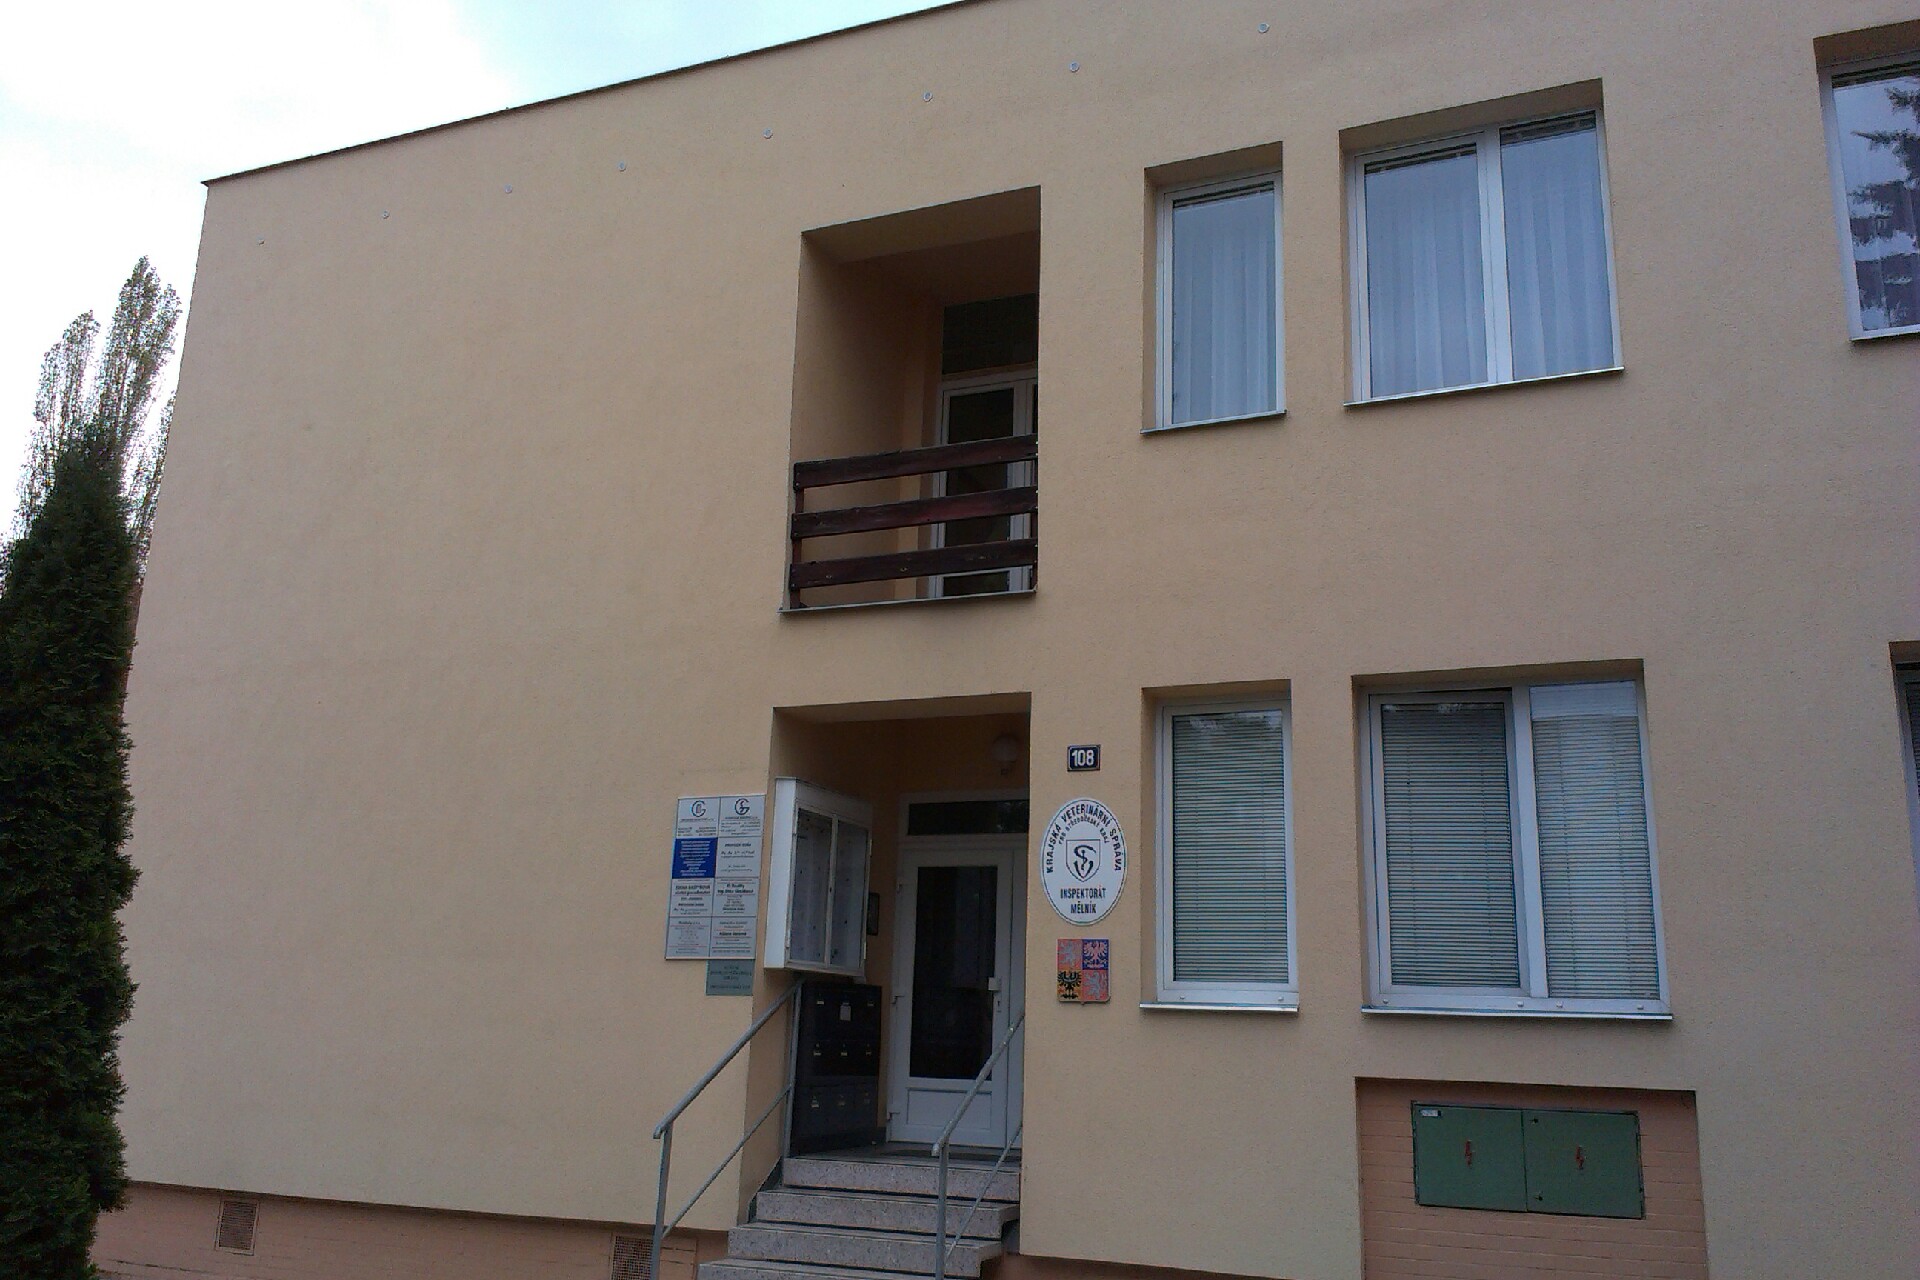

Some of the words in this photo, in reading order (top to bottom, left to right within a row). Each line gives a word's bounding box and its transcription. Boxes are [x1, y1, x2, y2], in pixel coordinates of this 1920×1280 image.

[1071, 749, 1094, 767] 108
[1046, 822, 1062, 874] KRAJSKÁ
[1061, 803, 1113, 828] VETERINÁRNÍ
[1109, 828, 1122, 872] SPRÁVA
[1060, 885, 1107, 900] INSPEKTORÁT
[1070, 901, 1097, 914] MĚLNÍK
